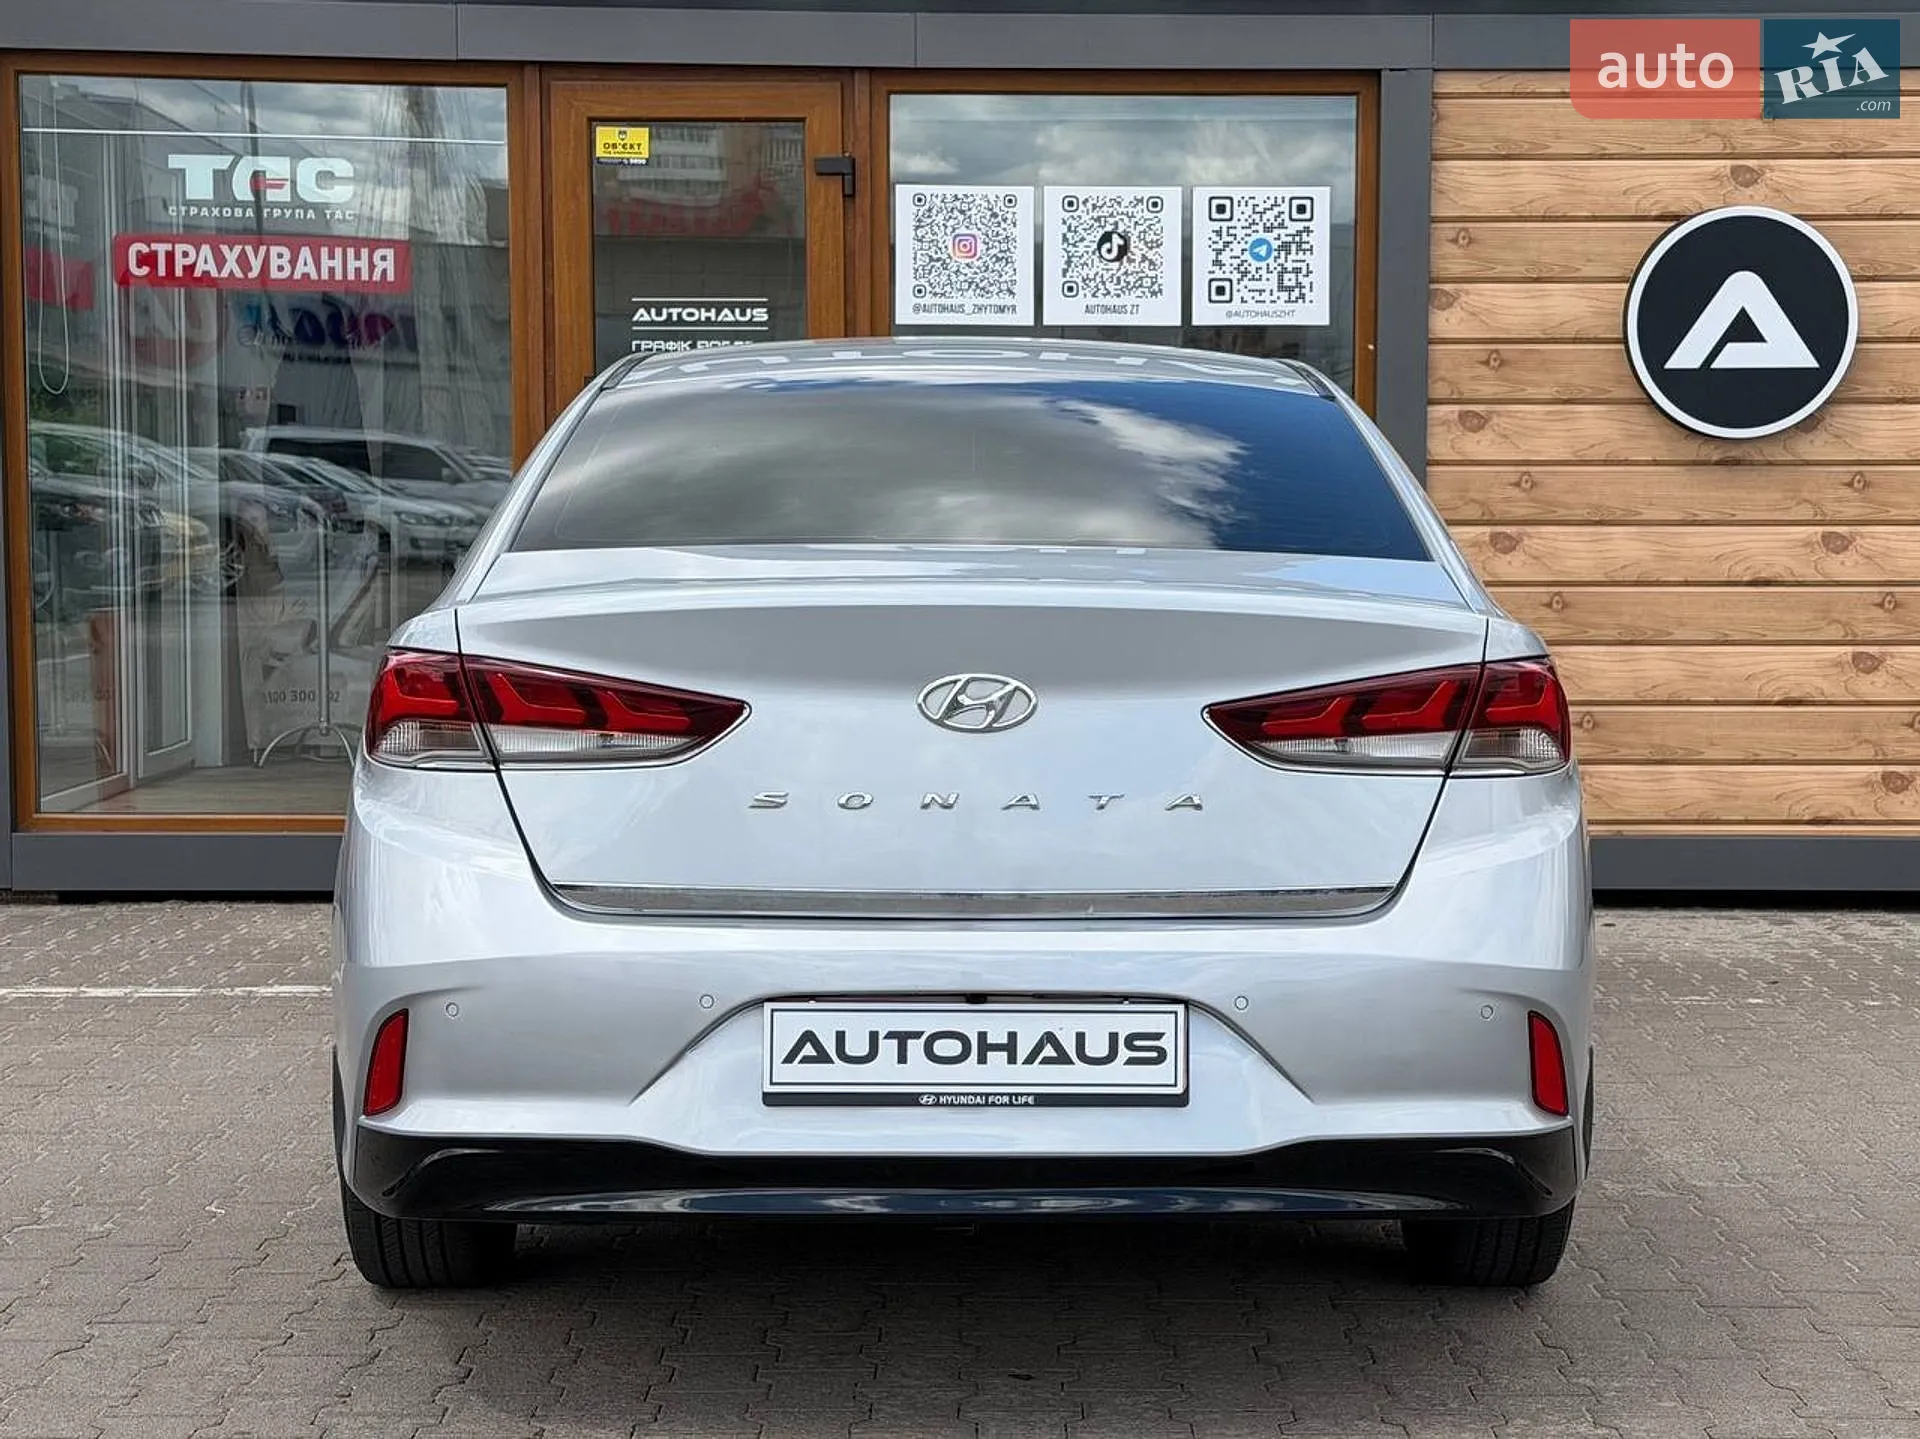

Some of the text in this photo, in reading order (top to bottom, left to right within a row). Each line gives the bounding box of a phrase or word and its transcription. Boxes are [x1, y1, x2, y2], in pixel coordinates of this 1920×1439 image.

[167, 205, 355, 220] СТРАХОВА ГРУПА ТАС
[127, 241, 395, 282] СТРАХУВАННЯ
[631, 307, 769, 322] AUTOHAUS
[1084, 304, 1128, 315] AUTOHAUS
[631, 340, 693, 352] ГРАФІК
[748, 791, 1205, 810] SONATA
[780, 1029, 1169, 1066] AUTOHAUS
[939, 1094, 1035, 1105] HYUNDAI FOR LIFE
